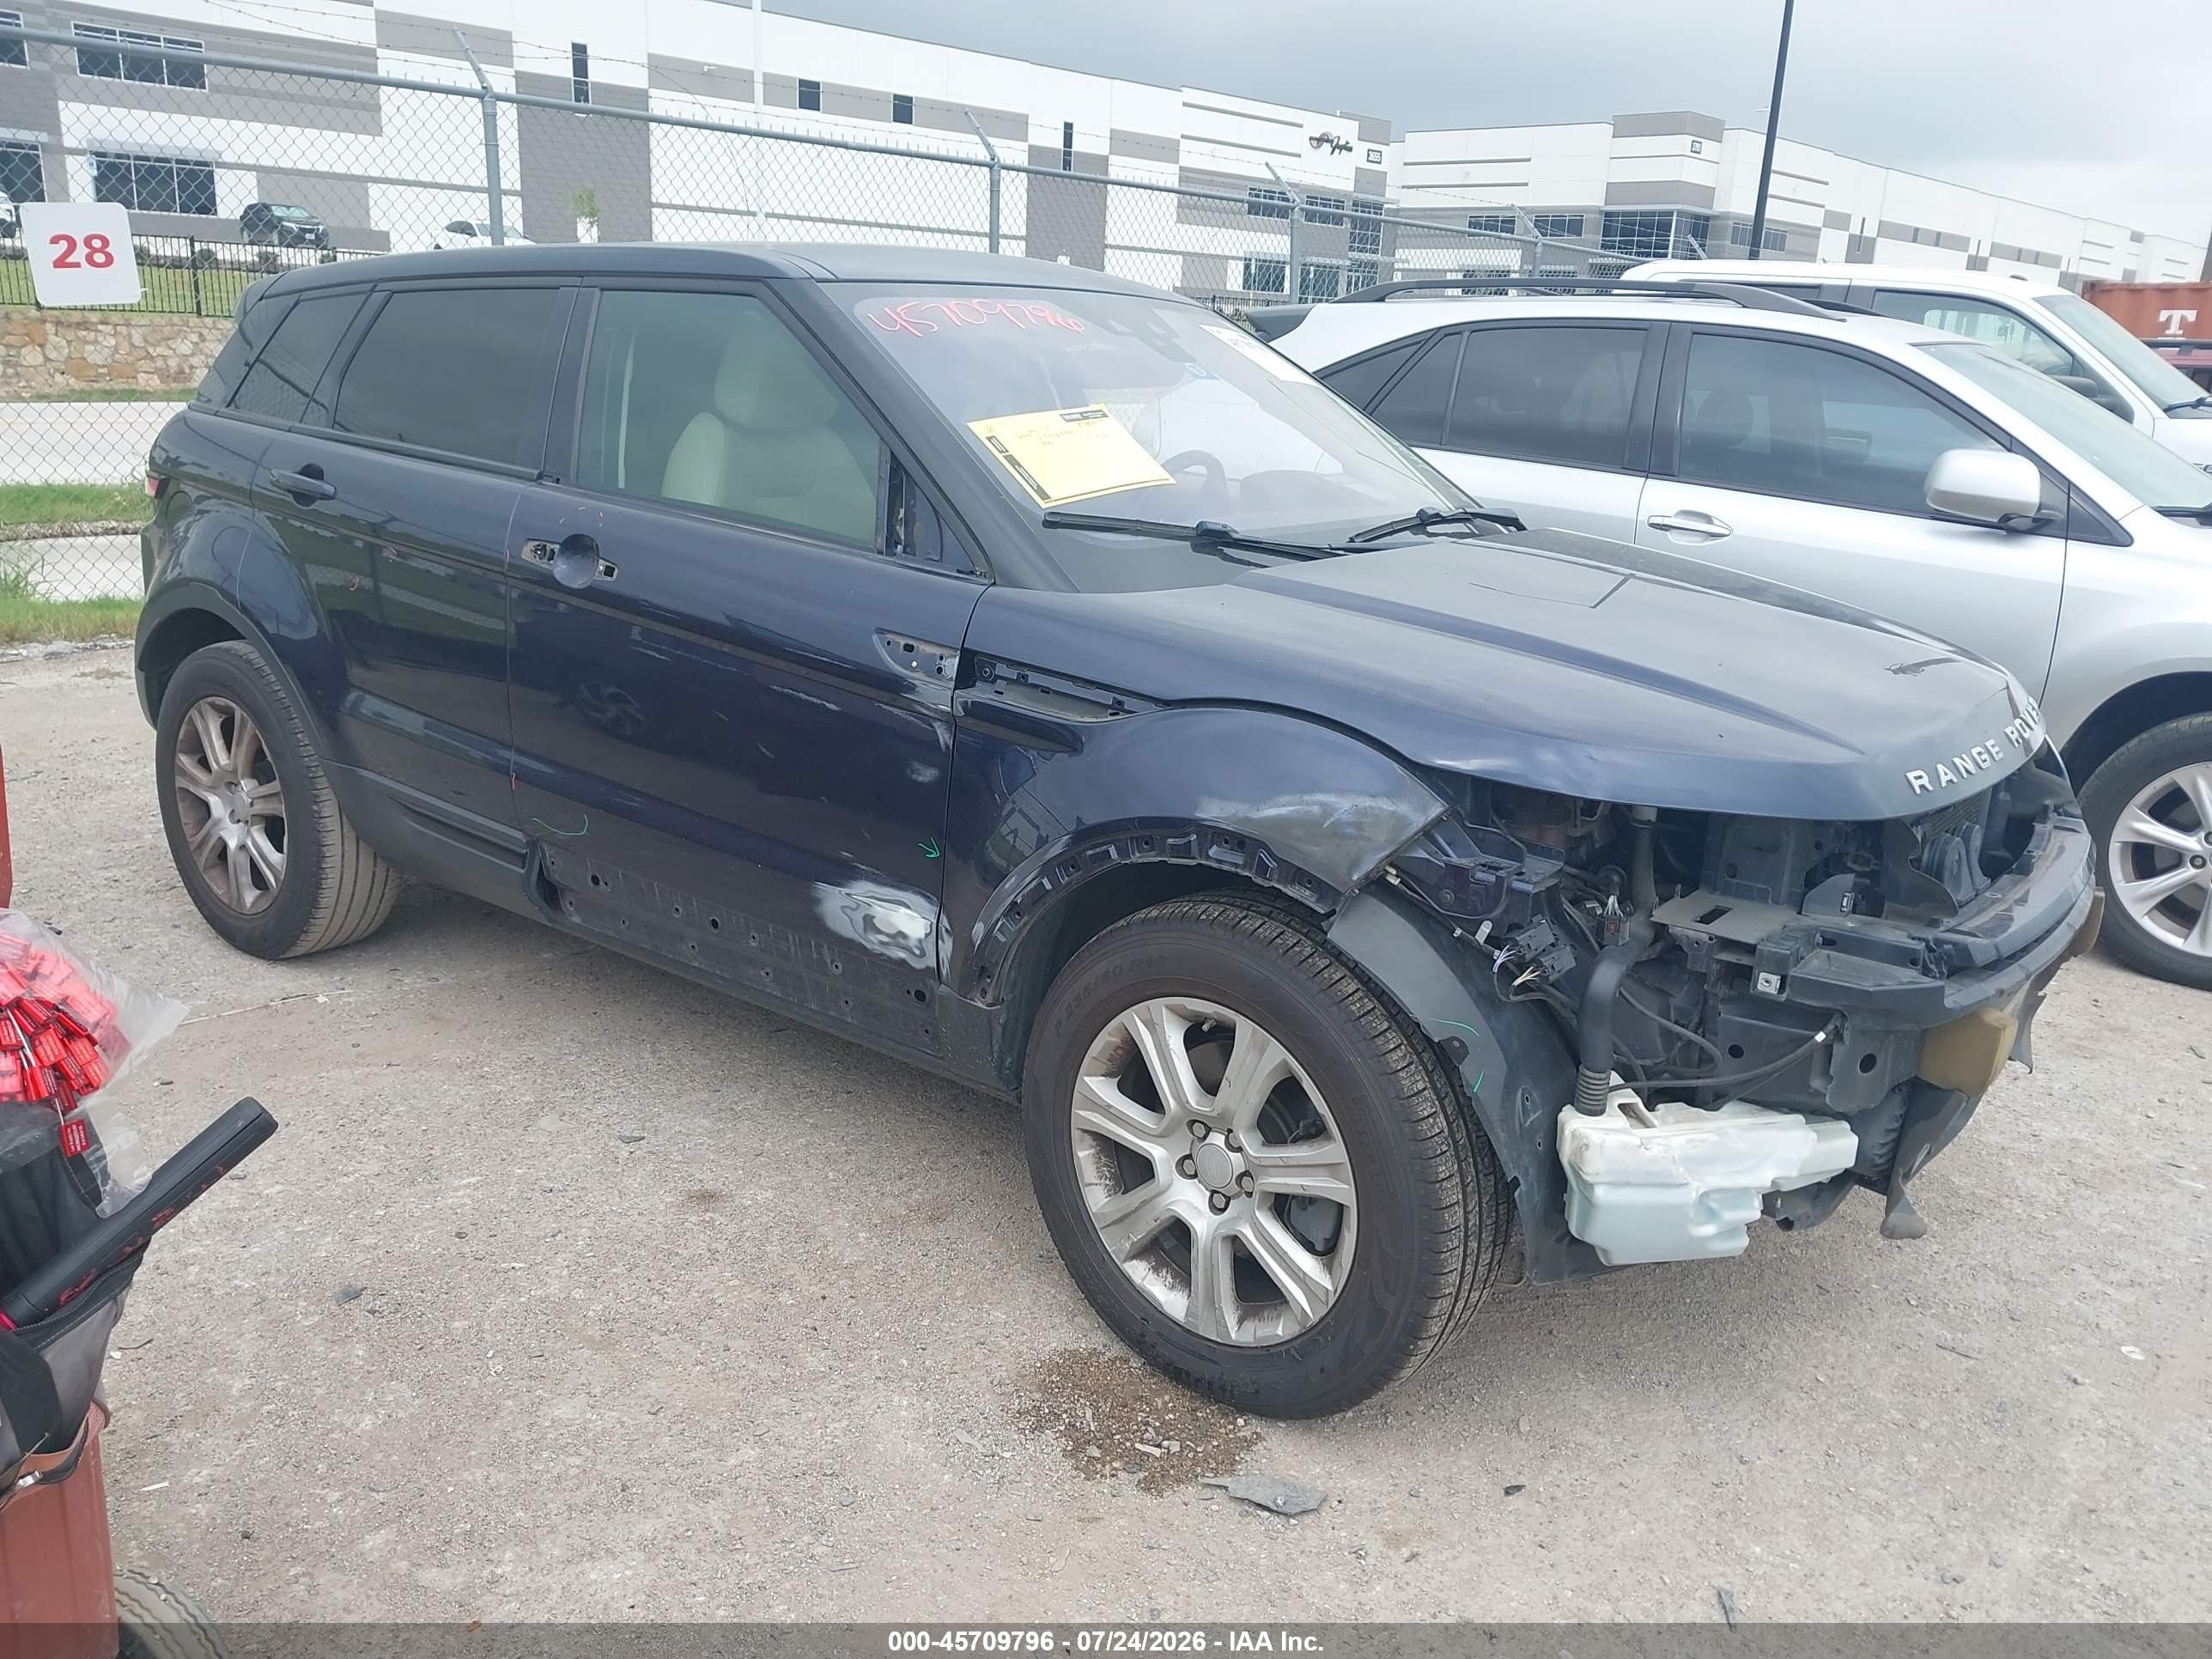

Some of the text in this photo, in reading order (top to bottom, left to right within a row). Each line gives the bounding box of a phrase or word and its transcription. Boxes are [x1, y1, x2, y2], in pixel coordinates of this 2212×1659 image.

[49, 233, 115, 269] 28
[866, 299, 1085, 337] 45709796
[2158, 309, 2197, 335] T
[1905, 738, 2005, 795] RANGE
